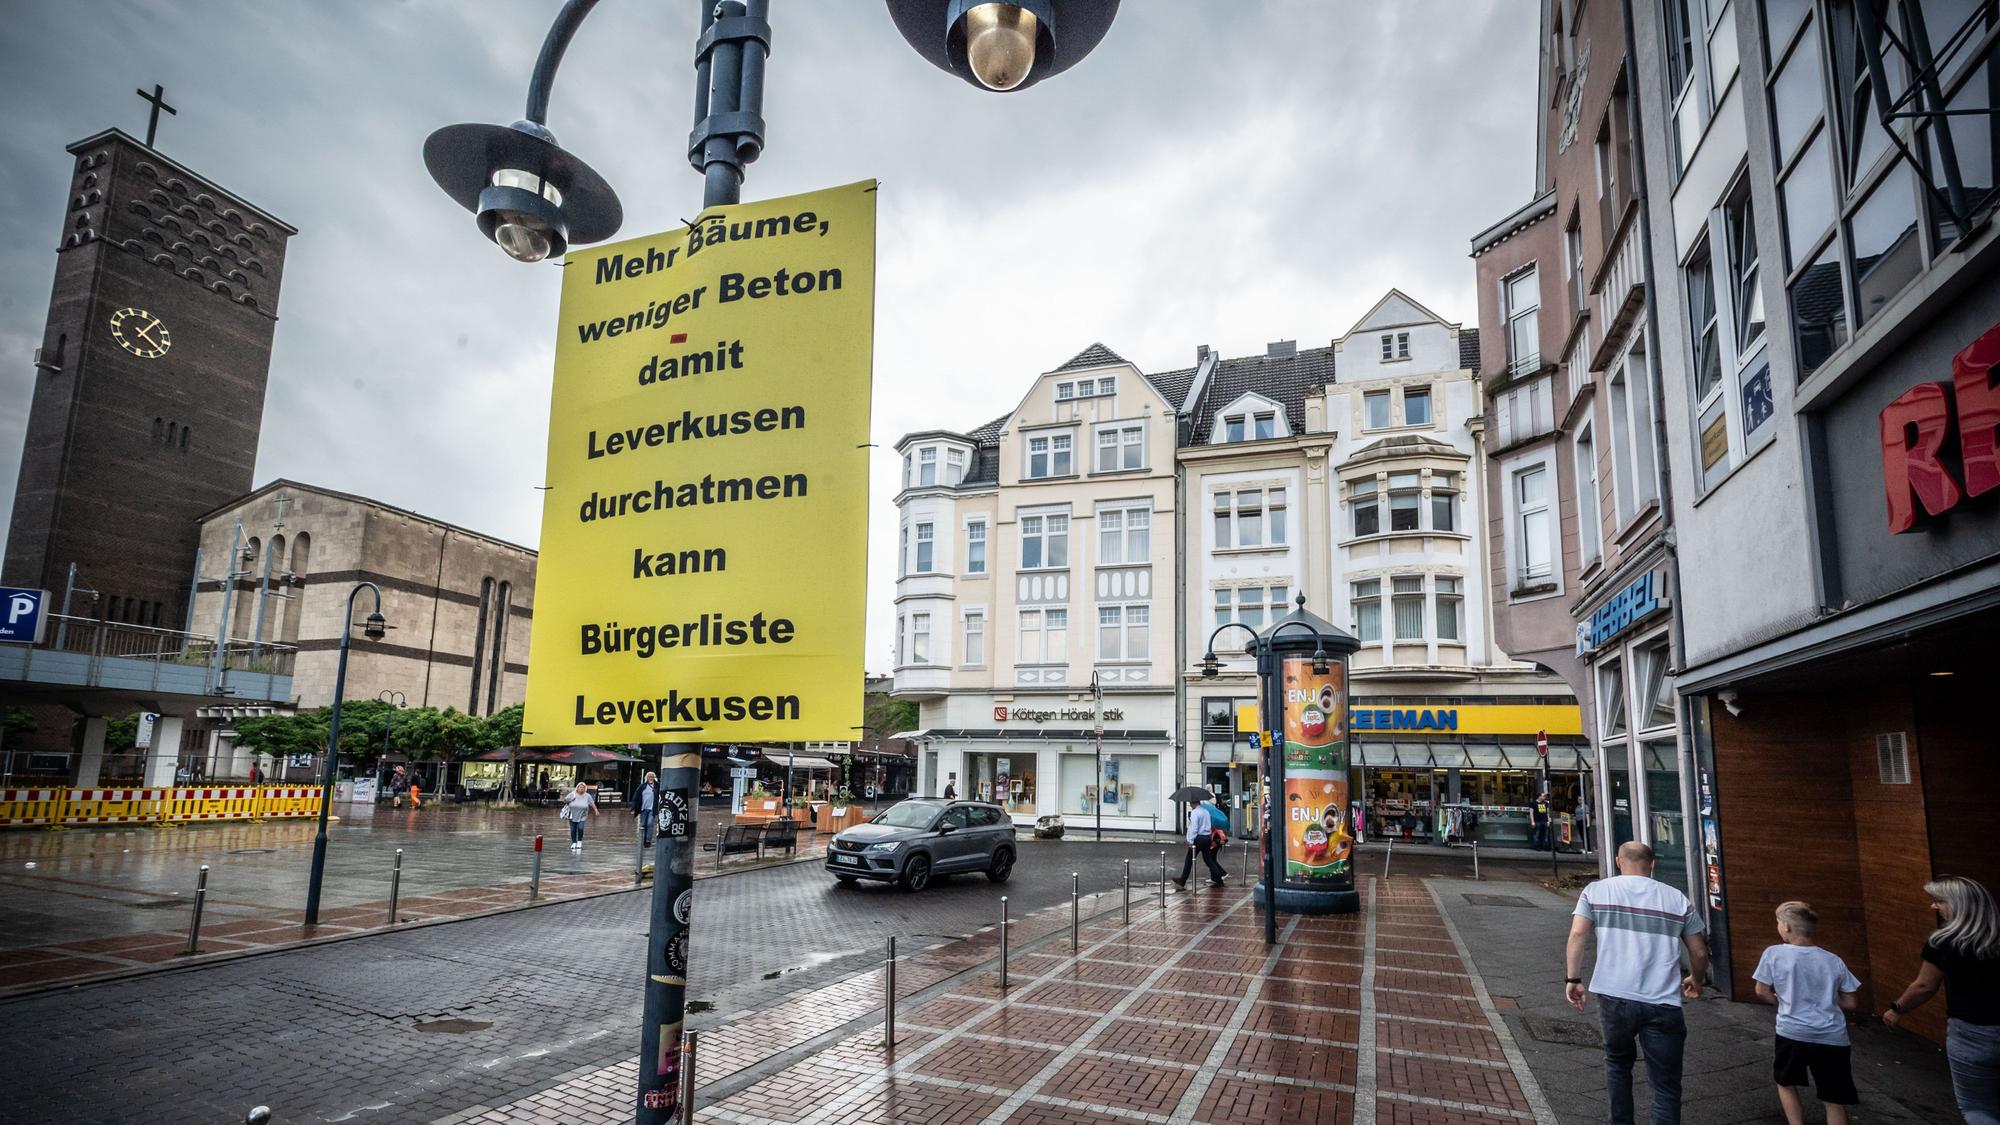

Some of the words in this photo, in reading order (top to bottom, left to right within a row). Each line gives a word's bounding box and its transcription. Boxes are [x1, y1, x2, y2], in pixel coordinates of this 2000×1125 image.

[596, 247, 680, 284] Mehr
[686, 210, 829, 257] Bäume,
[579, 284, 707, 343] weniger
[719, 268, 842, 303] Beton
[639, 339, 744, 386] damit
[588, 405, 805, 460] Leverkusen
[580, 473, 808, 522] durchatmen
[633, 547, 726, 579] kann
[8, 597, 34, 624] P
[1591, 569, 1659, 649] HEBBEL
[581, 611, 795, 658] Bürgerliste
[575, 689, 800, 725] Leverkusen
[1012, 708, 1057, 723] Köttgen
[1061, 708, 1124, 721] Hörakstik
